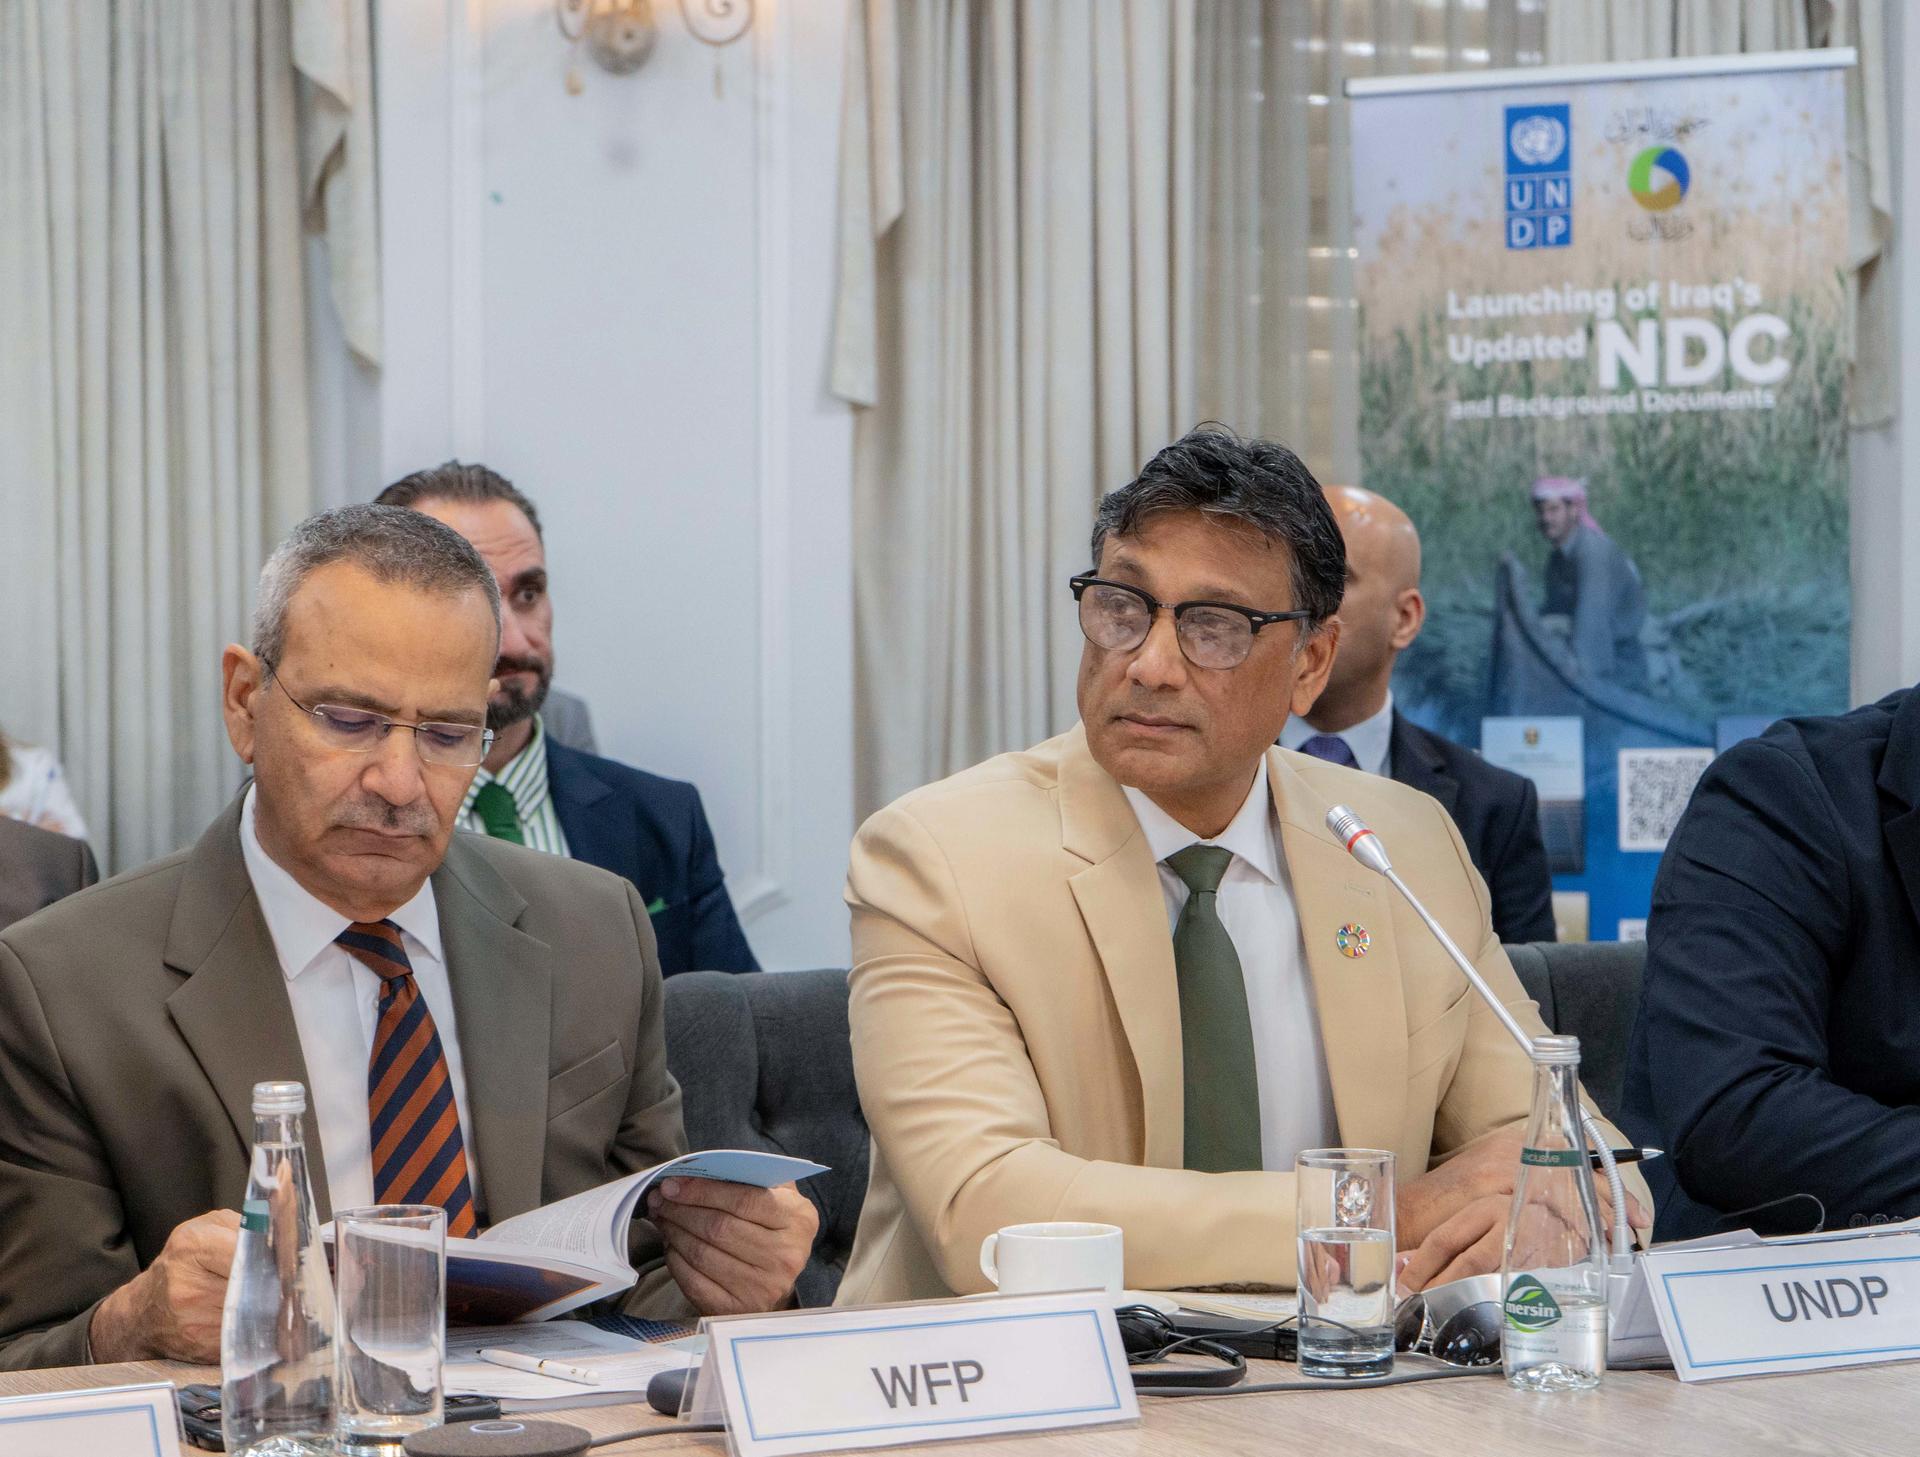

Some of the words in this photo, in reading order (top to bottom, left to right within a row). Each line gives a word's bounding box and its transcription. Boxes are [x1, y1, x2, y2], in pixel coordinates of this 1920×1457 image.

[1448, 281, 1616, 320] Launching
[1625, 279, 1660, 311] of
[1669, 276, 1761, 314] Iraq's
[1448, 327, 1586, 369] Updated
[1599, 313, 1792, 388] NDC
[1450, 394, 1494, 420] and
[1498, 391, 1638, 420] Background
[1643, 387, 1776, 413] Documents
[1505, 1301, 1557, 1319] mersin
[1761, 1275, 1889, 1323] UNDP
[870, 1359, 984, 1409] WFP
